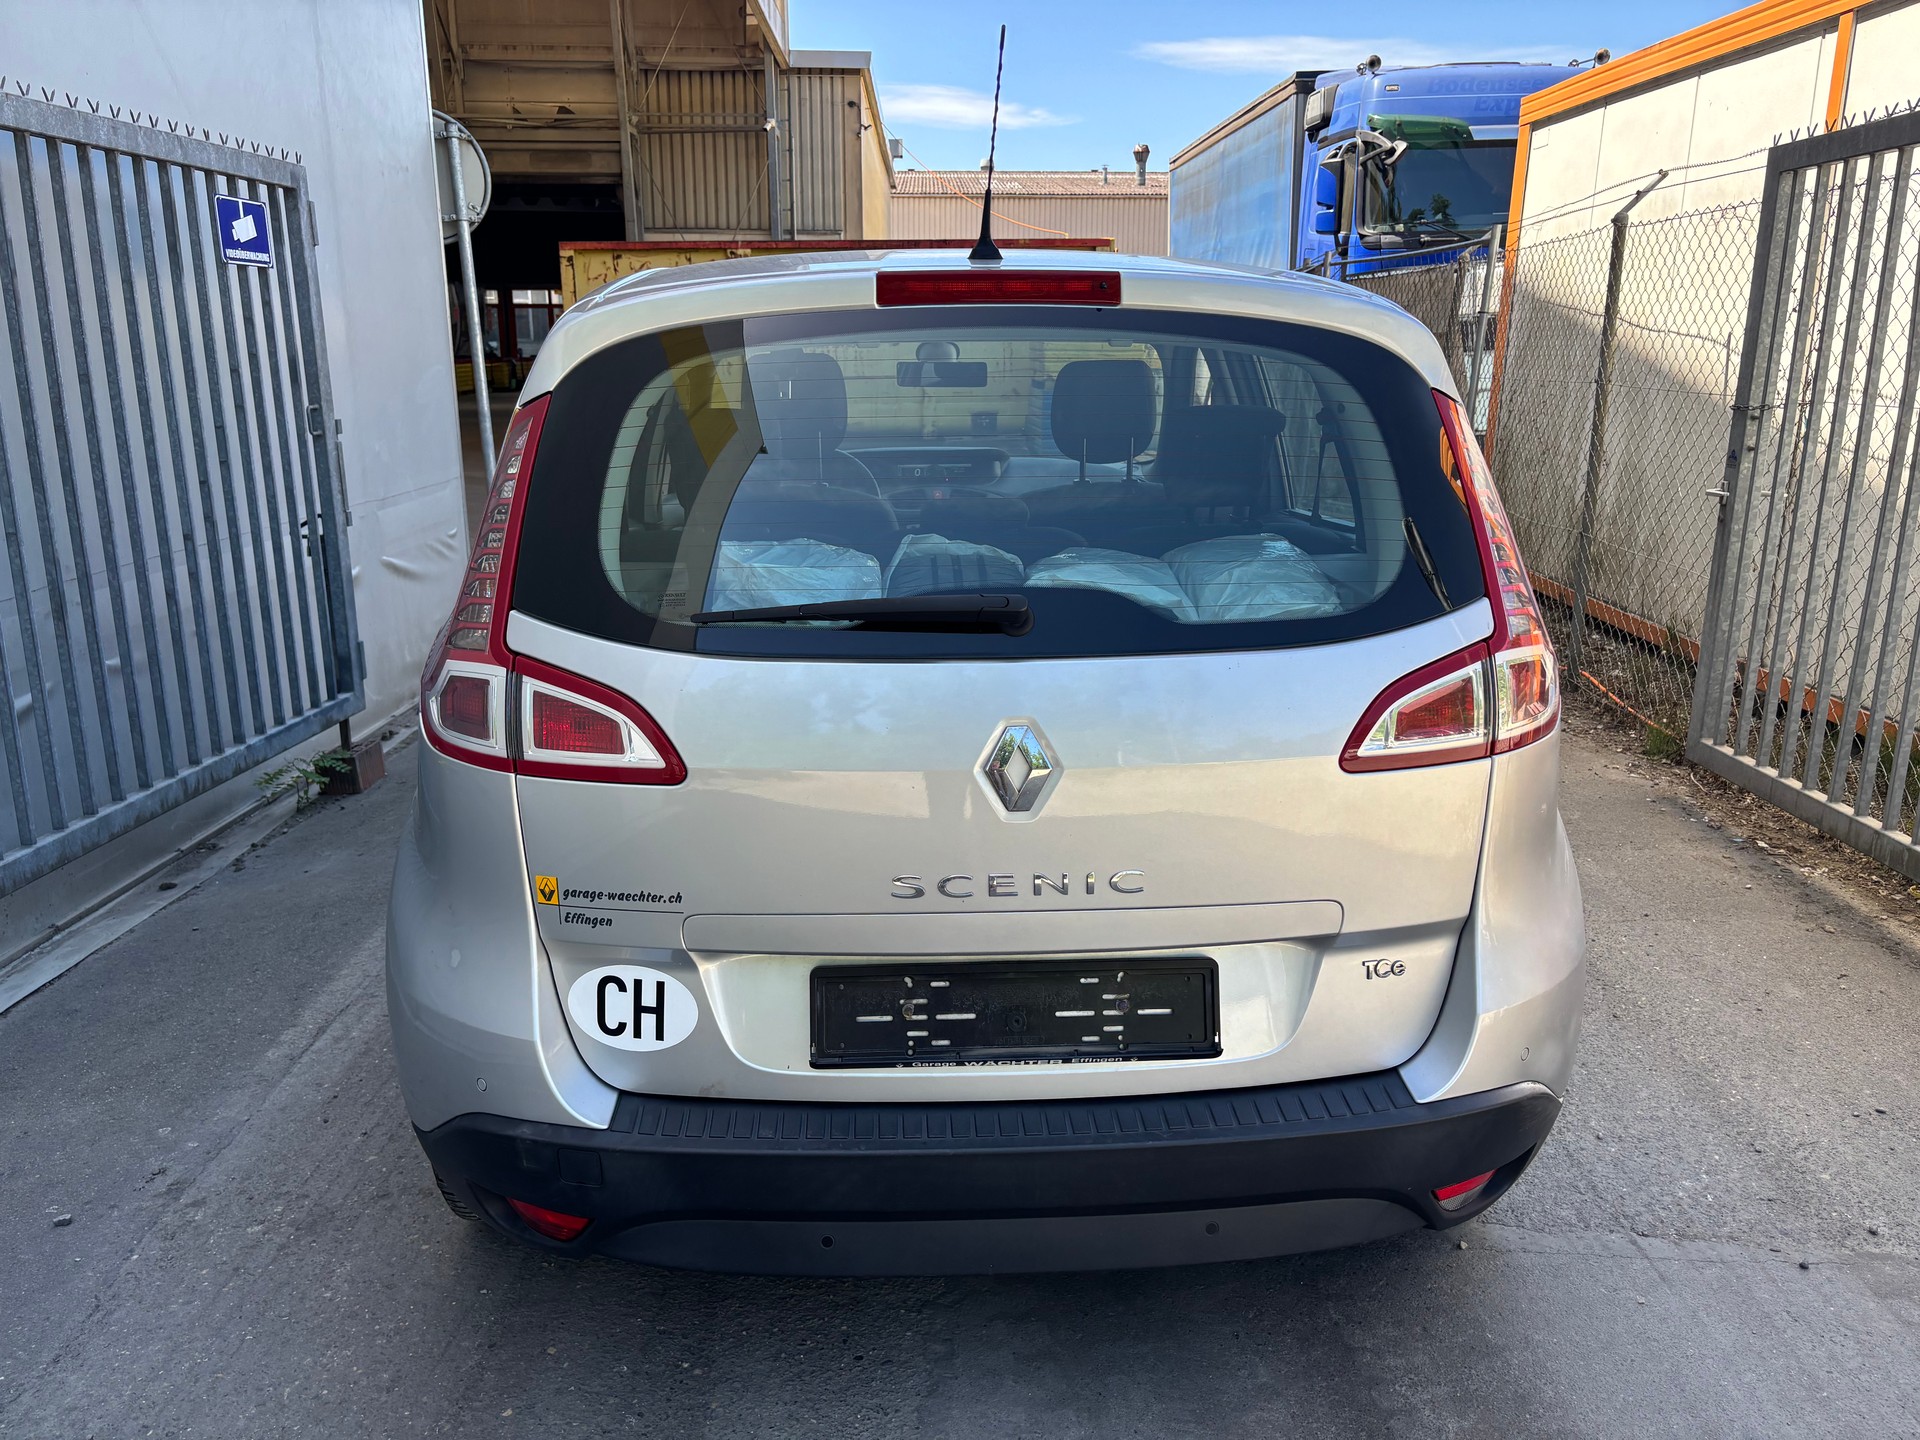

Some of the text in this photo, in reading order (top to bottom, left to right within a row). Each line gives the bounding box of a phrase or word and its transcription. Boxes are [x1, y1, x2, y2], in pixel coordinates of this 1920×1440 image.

[1427, 77, 1545, 93] Bodensee
[891, 869, 1145, 899] SCENIC
[562, 888, 683, 904] garage-waechter.ch
[564, 912, 613, 928] Effingen
[1362, 958, 1407, 980] TCe
[597, 975, 666, 1042] CH
[1071, 1056, 1123, 1064] Effingen
